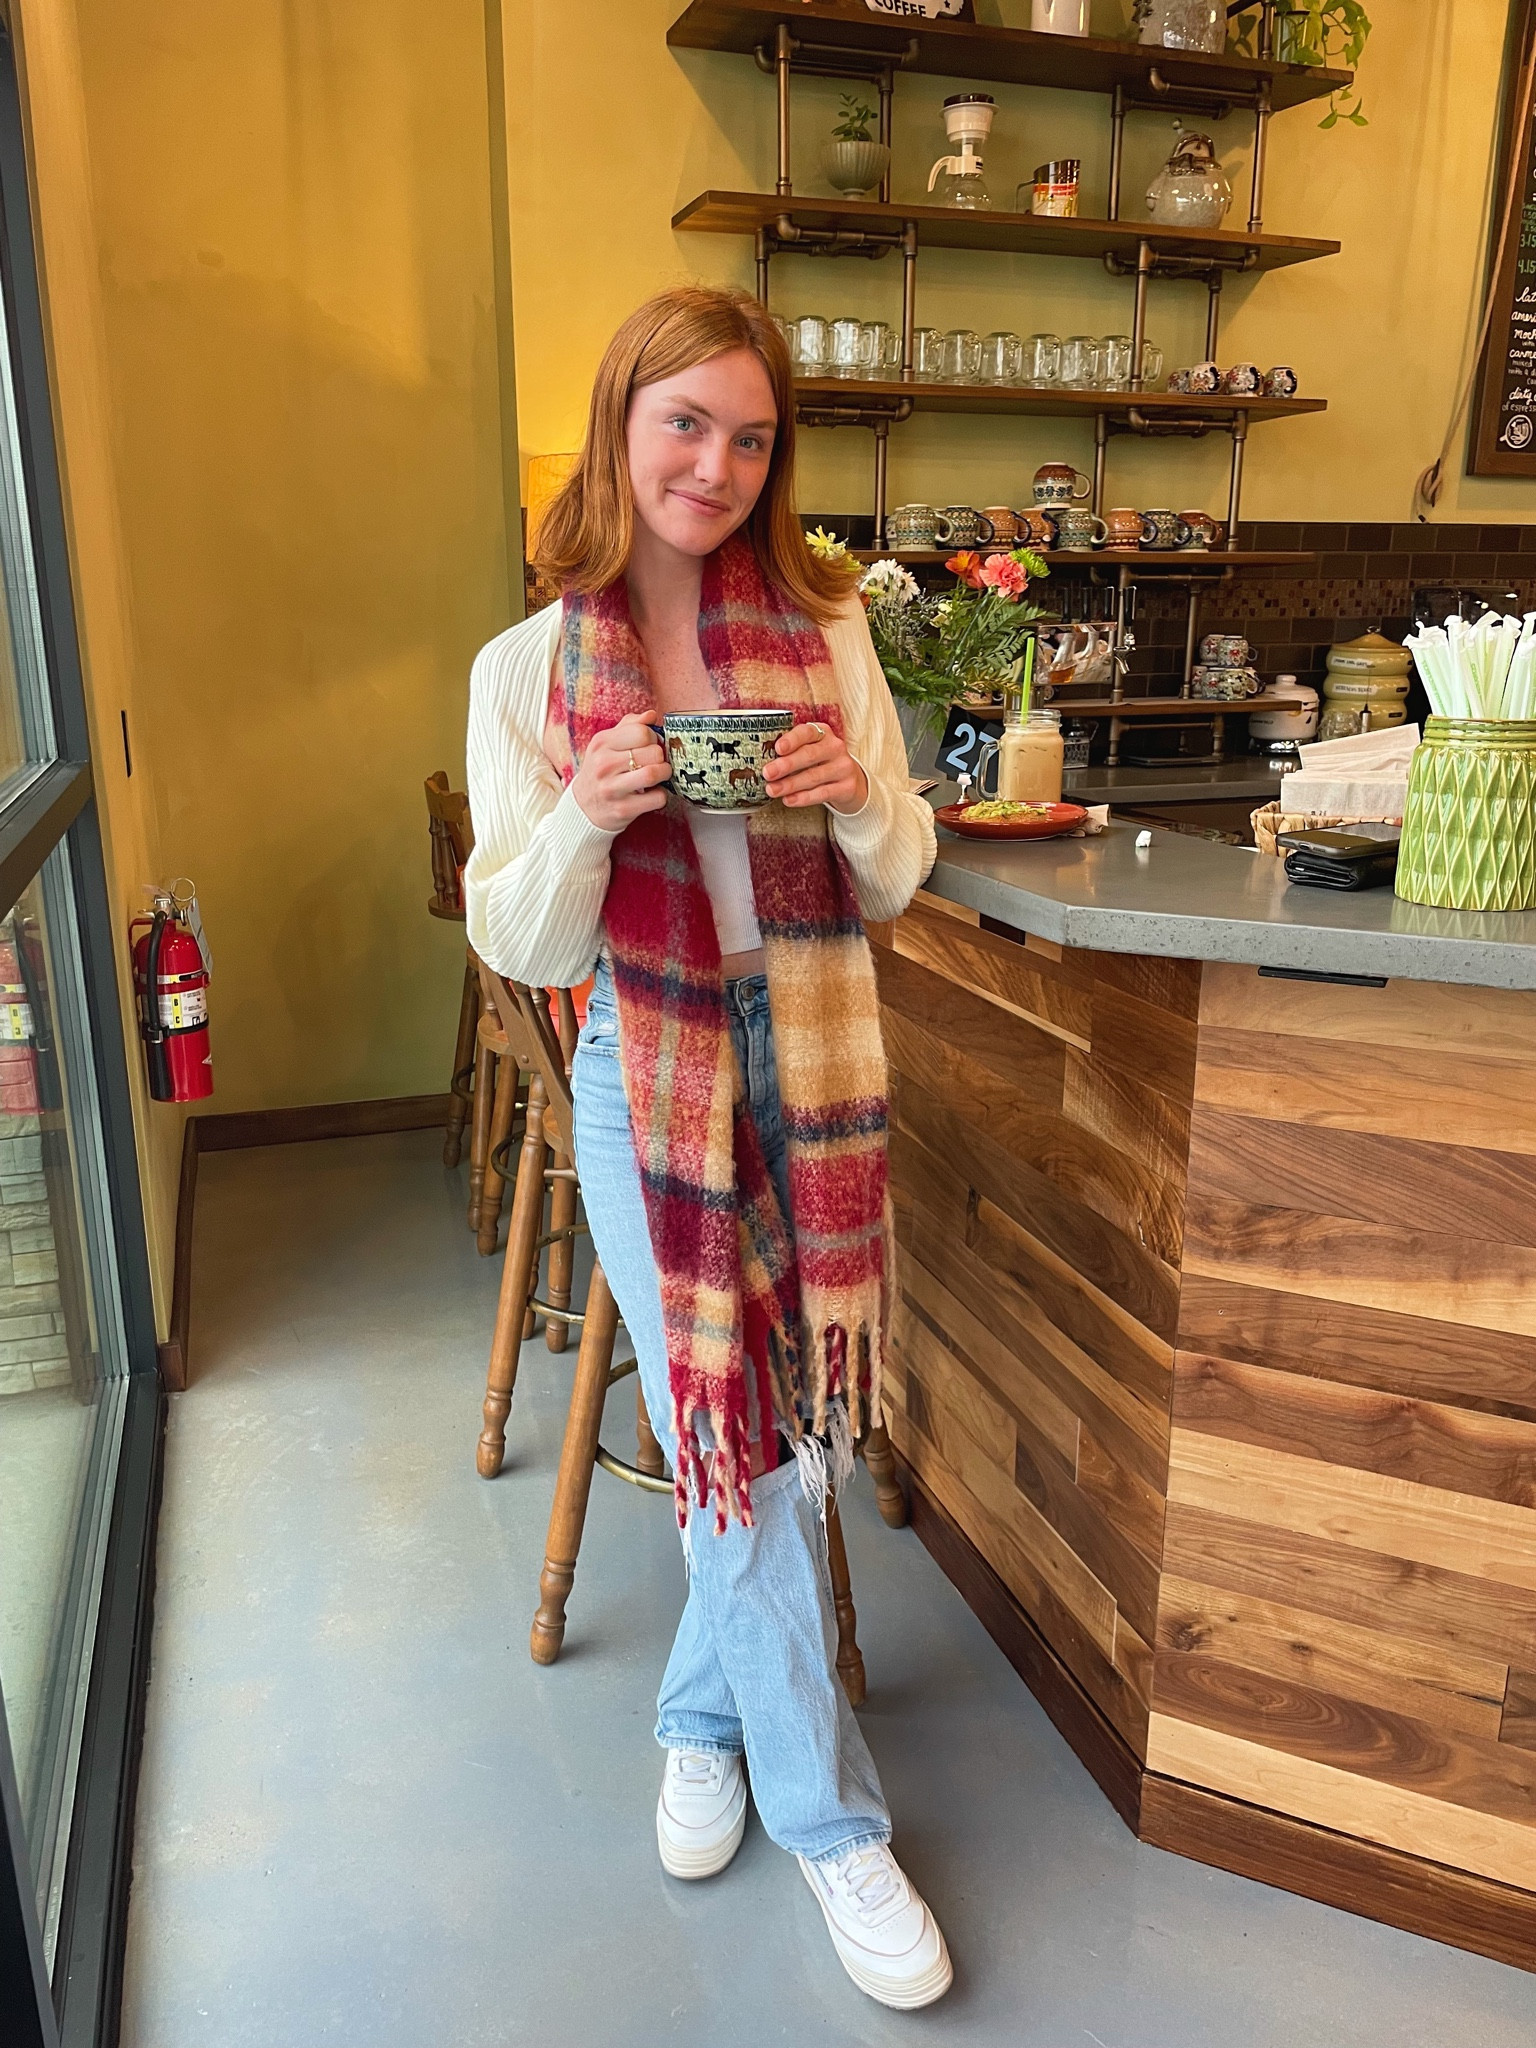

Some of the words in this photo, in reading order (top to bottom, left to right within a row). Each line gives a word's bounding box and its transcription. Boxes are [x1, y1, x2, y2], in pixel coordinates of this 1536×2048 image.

[1518, 259, 1536, 274] 4.15
[1509, 386, 1533, 406] dirty
[946, 723, 999, 777] 27
